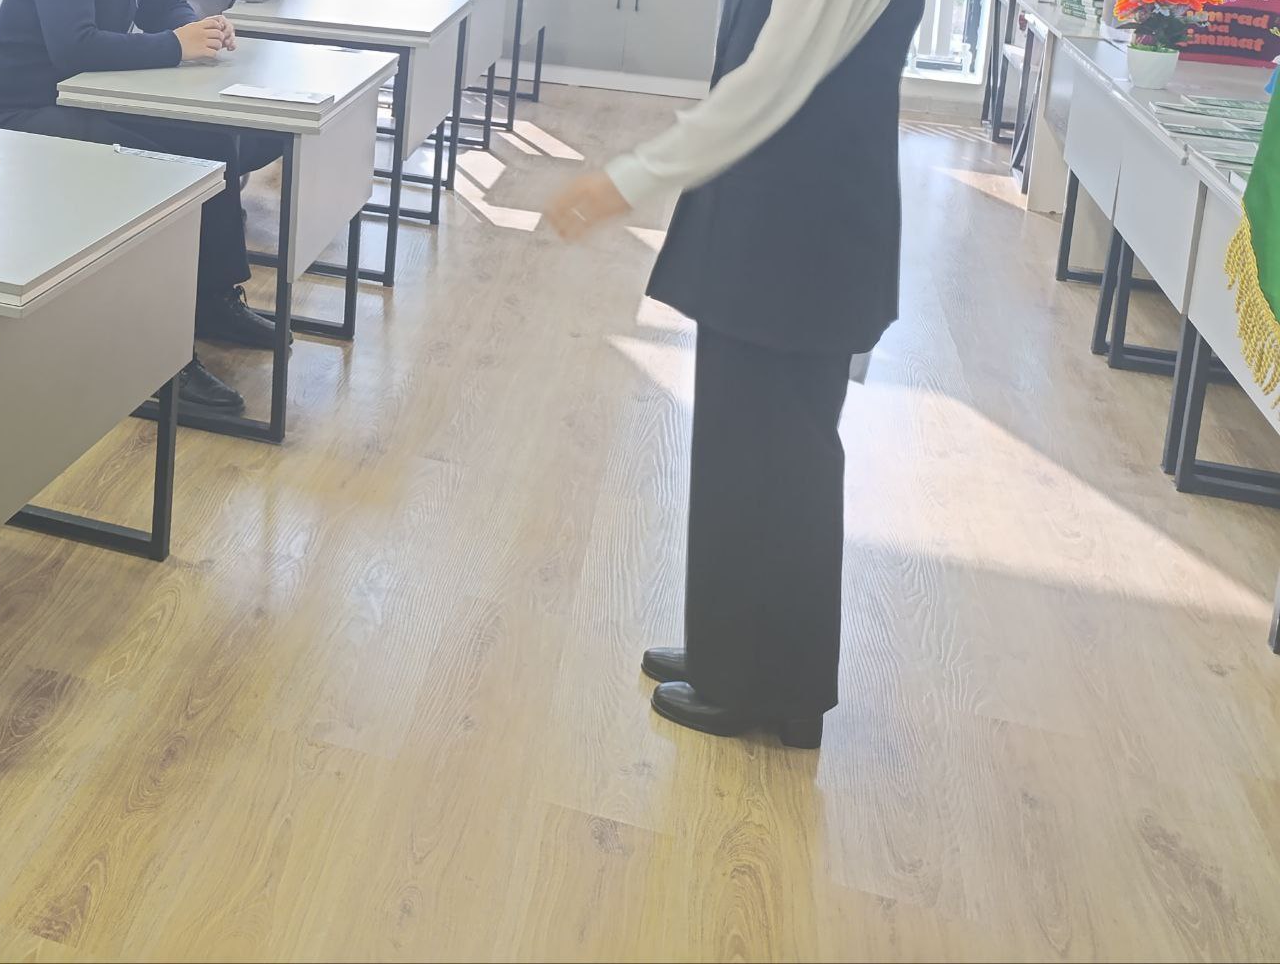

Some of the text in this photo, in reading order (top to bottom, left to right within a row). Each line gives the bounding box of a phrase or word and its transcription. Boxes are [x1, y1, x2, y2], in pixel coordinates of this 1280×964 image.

[1186, 10, 1270, 29] mrad
[1208, 23, 1230, 34] va
[1175, 28, 1265, 52] immat
